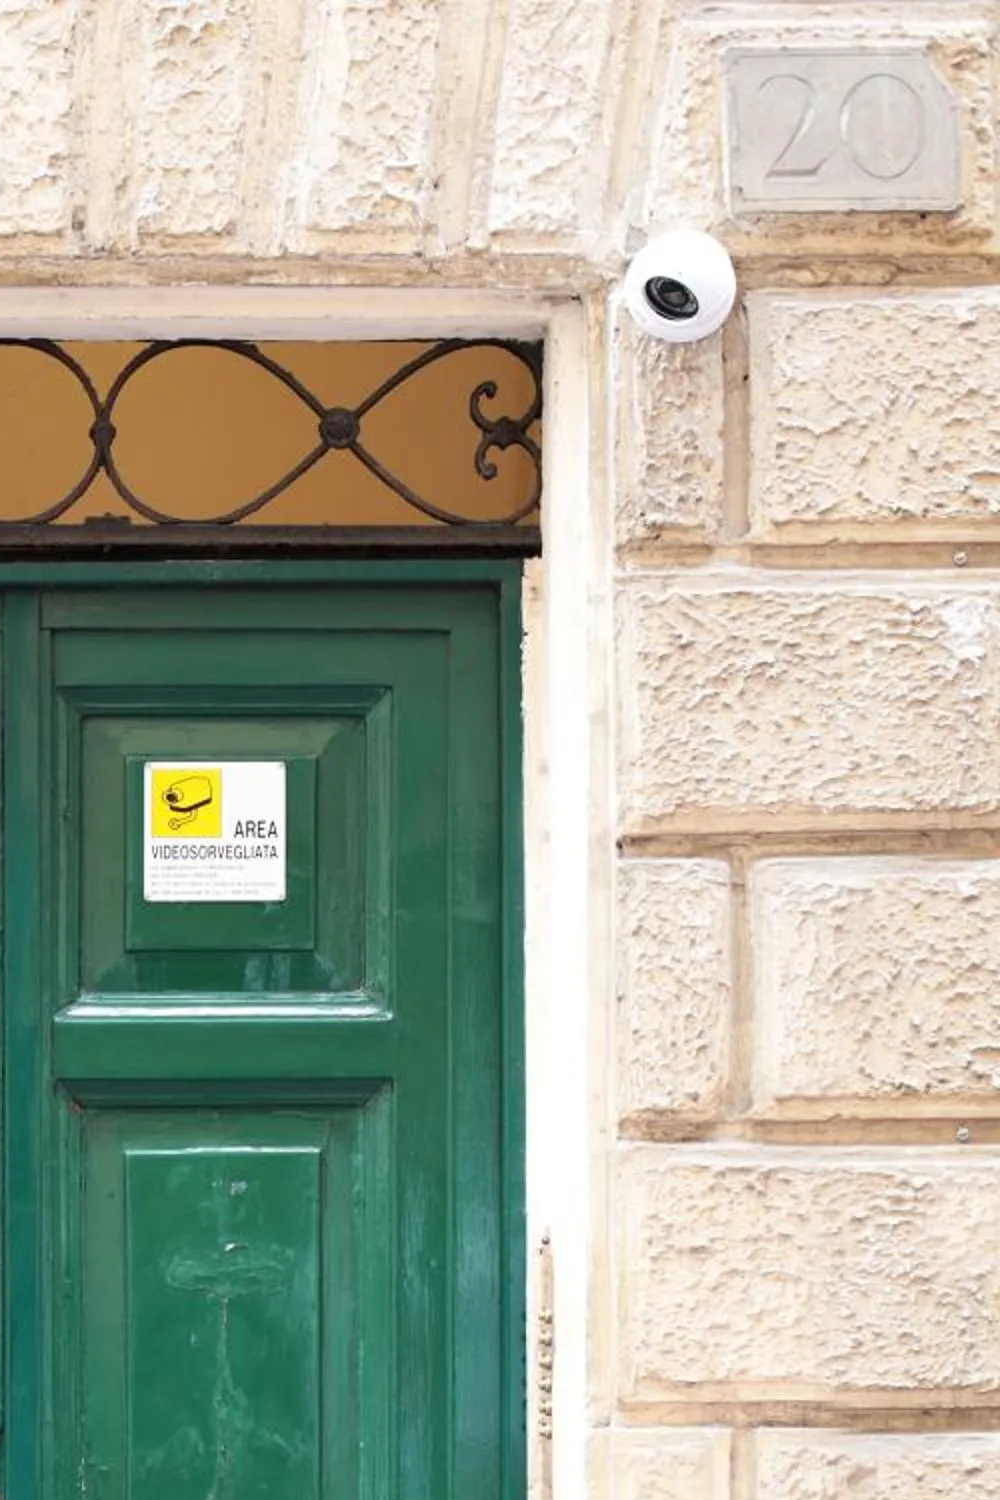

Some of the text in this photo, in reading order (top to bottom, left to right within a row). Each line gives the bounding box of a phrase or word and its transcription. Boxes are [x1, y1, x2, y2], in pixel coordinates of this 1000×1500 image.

[757, 73, 924, 180] 20
[233, 819, 278, 839] AREA
[151, 844, 279, 860] VIDEOSORVEGLIATA
